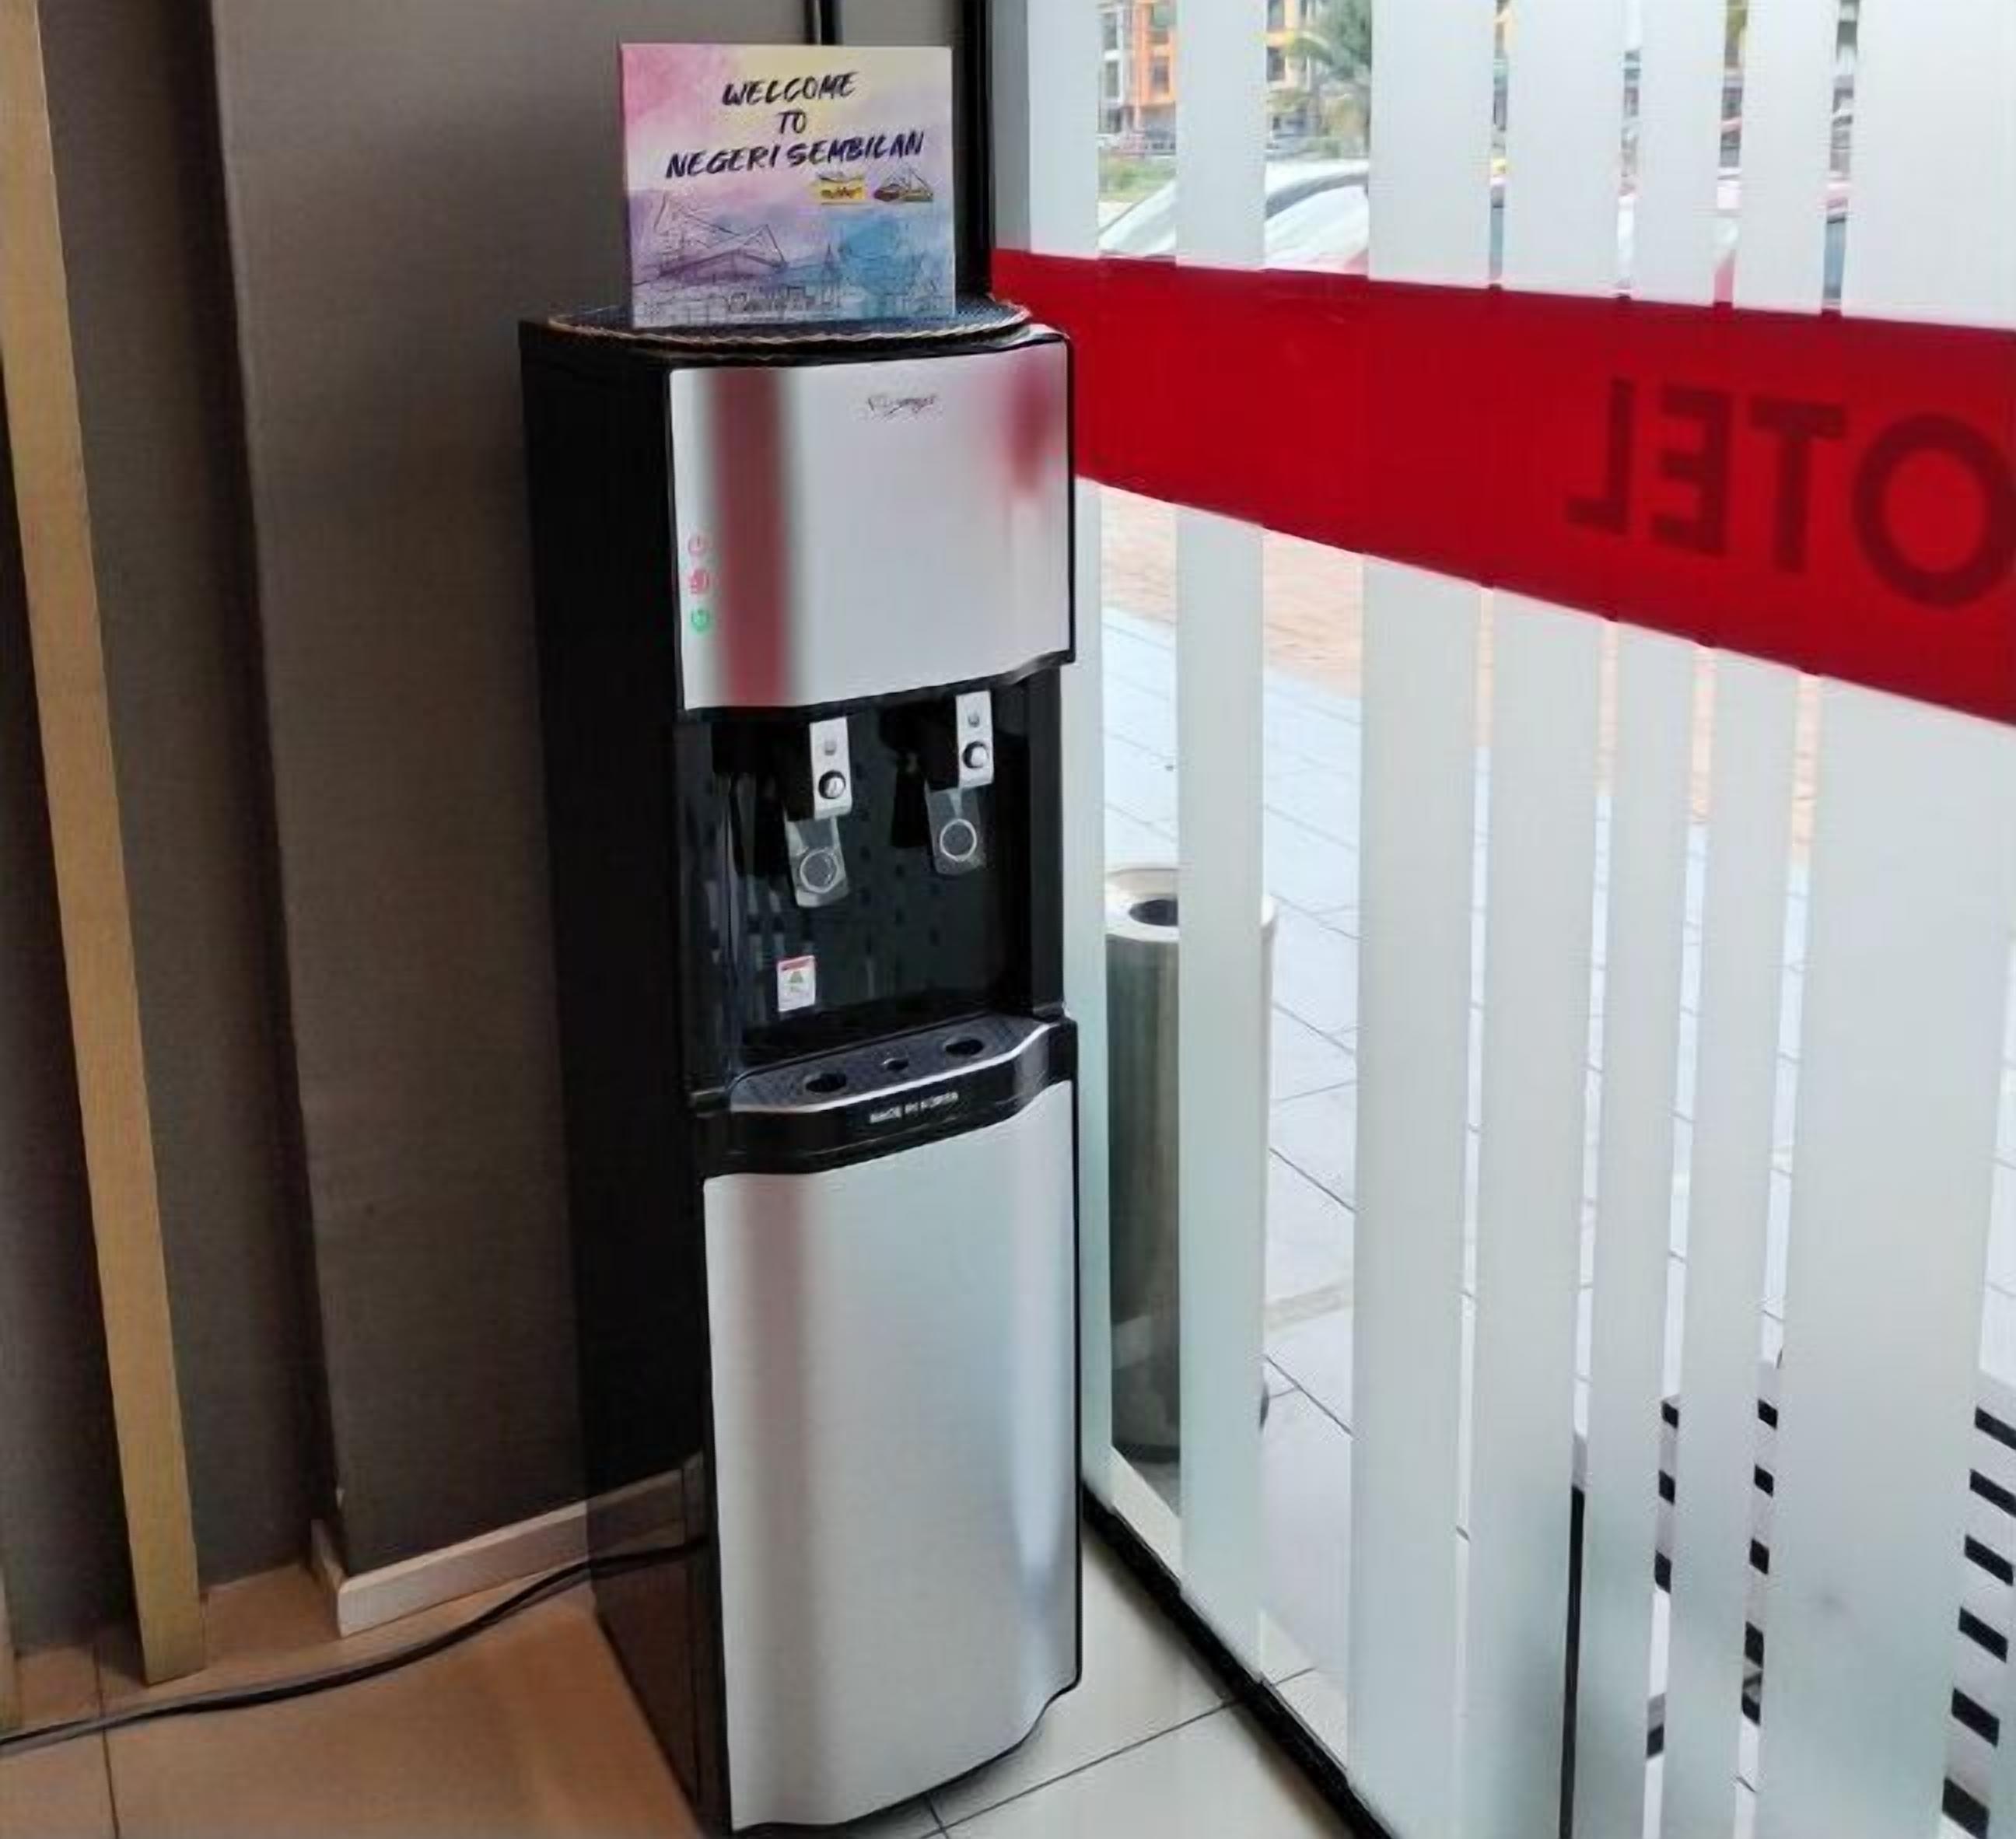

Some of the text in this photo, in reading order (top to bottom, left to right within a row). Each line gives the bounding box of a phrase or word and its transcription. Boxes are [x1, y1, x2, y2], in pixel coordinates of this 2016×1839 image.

[722, 72, 859, 106] WELCOME
[778, 110, 807, 135] TO
[666, 131, 924, 179] NEGERI SEMBILAN
